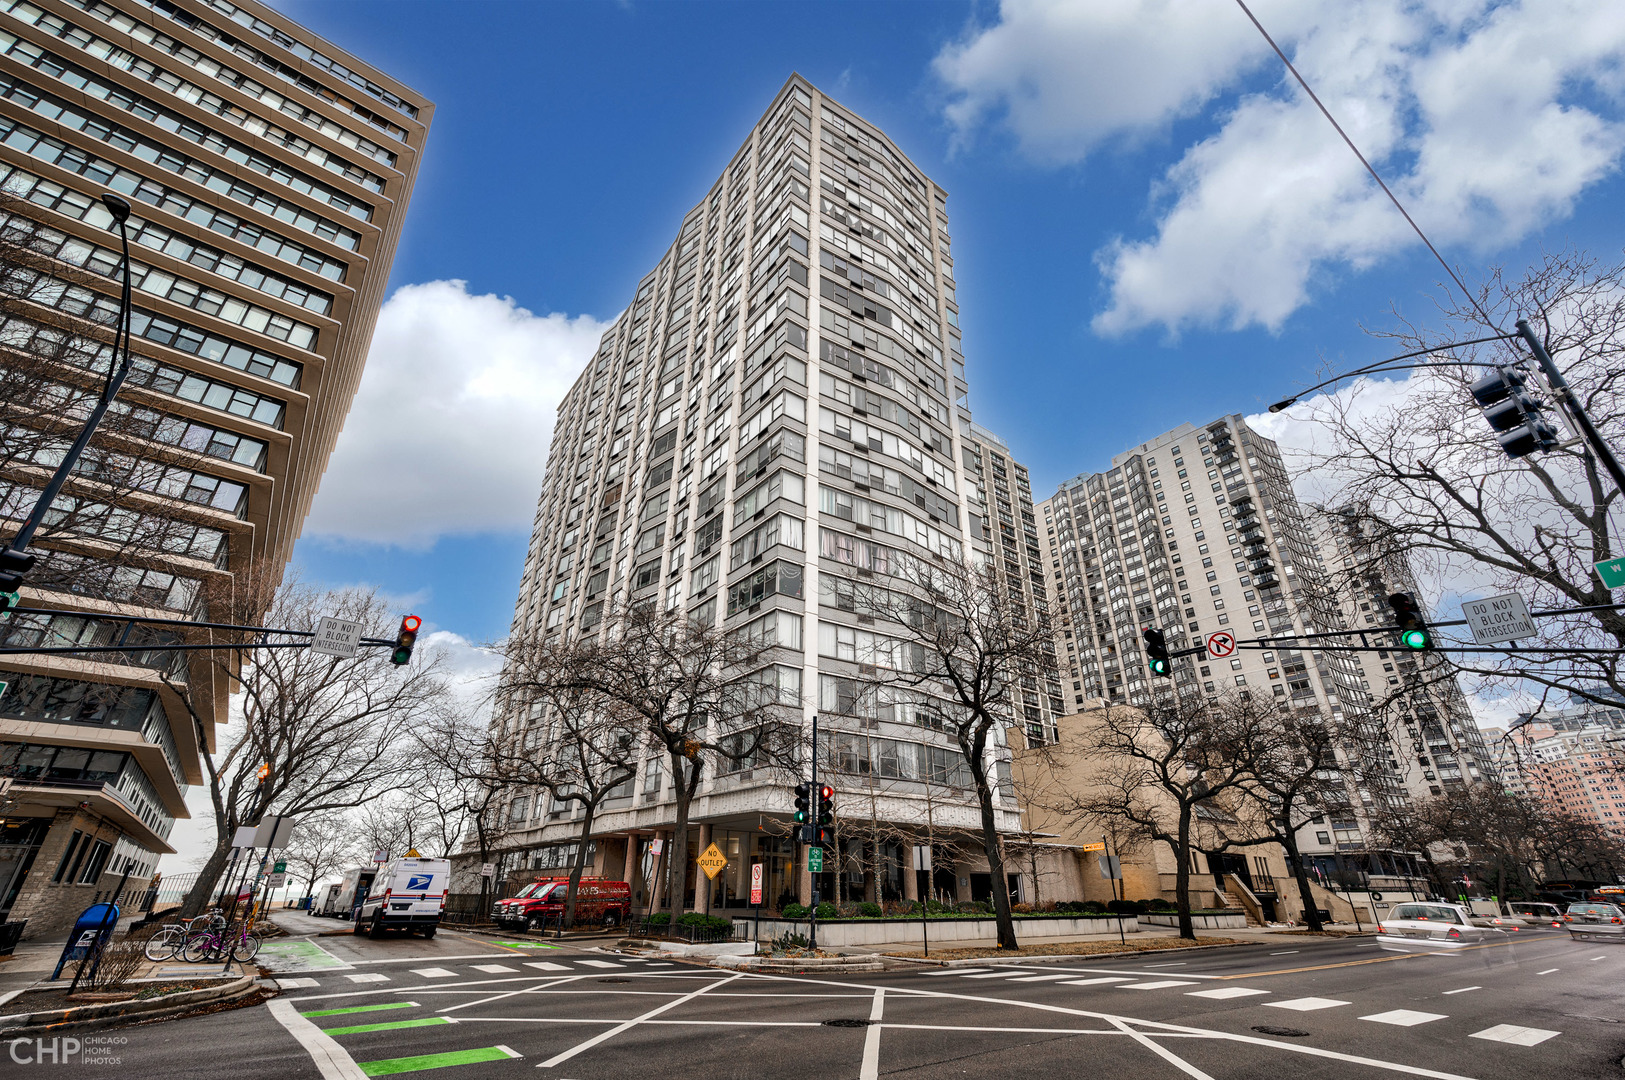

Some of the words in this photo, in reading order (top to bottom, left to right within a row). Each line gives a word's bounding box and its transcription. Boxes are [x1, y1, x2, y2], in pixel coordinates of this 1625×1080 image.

[1610, 563, 1621, 572] W
[1472, 603, 1487, 615] DO
[1491, 598, 1513, 611] NOT
[1480, 610, 1516, 626] BLOCK
[326, 620, 337, 630] DO
[341, 623, 356, 633] NOT
[1475, 620, 1532, 640] INTERSECTION
[325, 630, 351, 642] BLOCK
[315, 640, 354, 652] INTERSECTION
[700, 859, 724, 867] OUTLET
